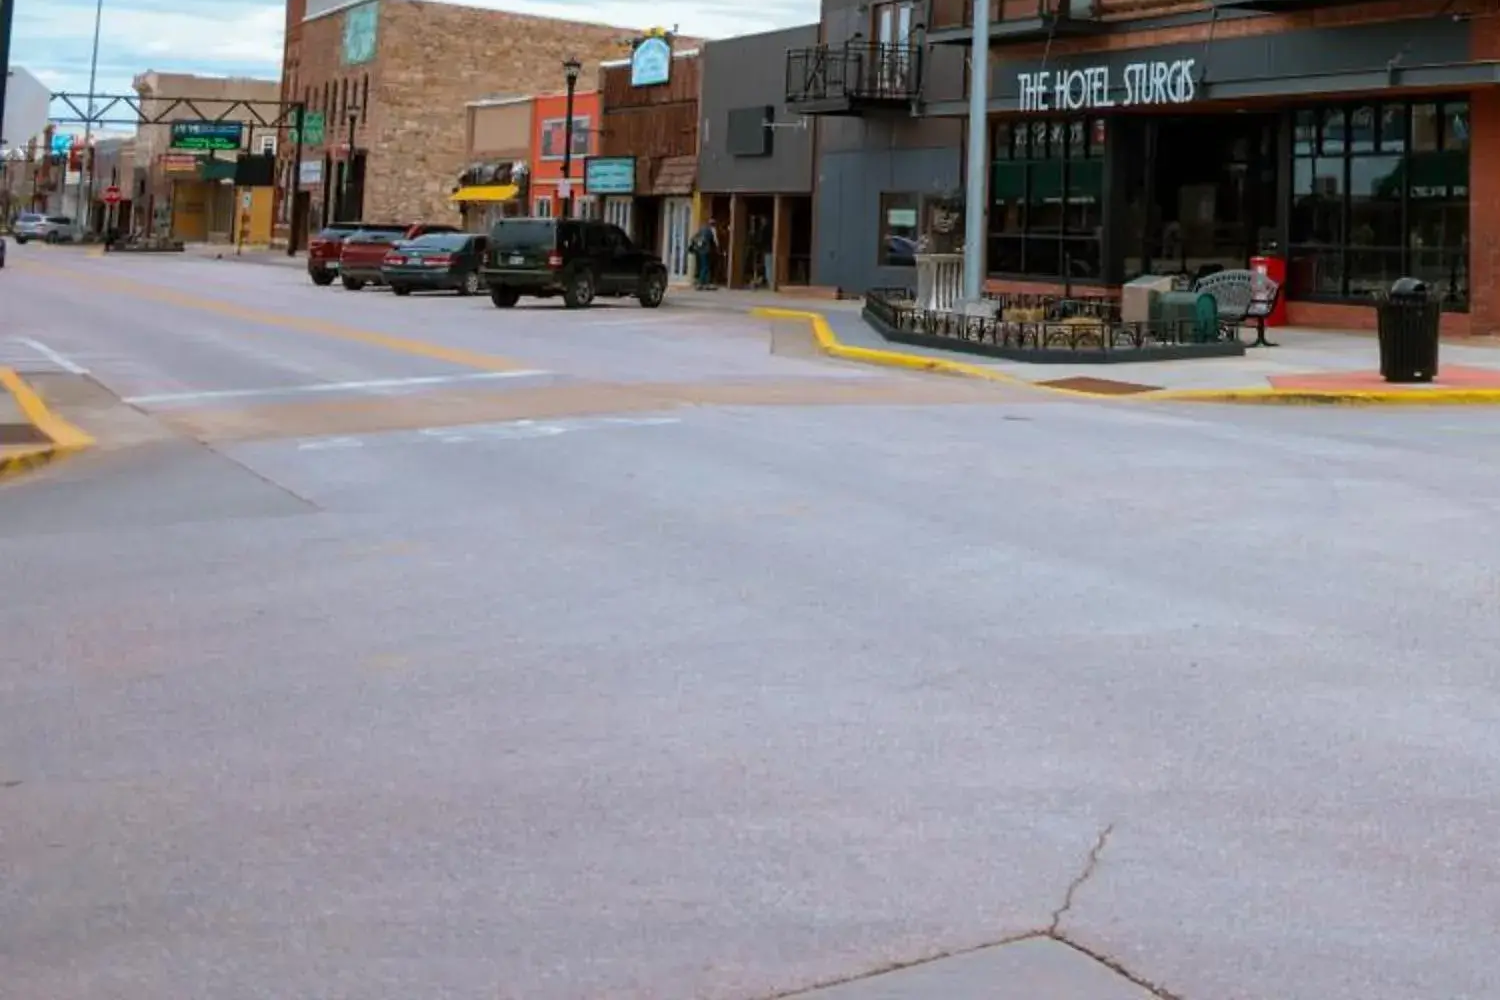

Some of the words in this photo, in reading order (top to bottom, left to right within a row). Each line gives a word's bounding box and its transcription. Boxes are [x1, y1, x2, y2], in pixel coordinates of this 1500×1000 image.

[1018, 71, 1050, 111] THE
[1055, 66, 1115, 110] HOTEL
[1123, 58, 1195, 106] STURGIS
